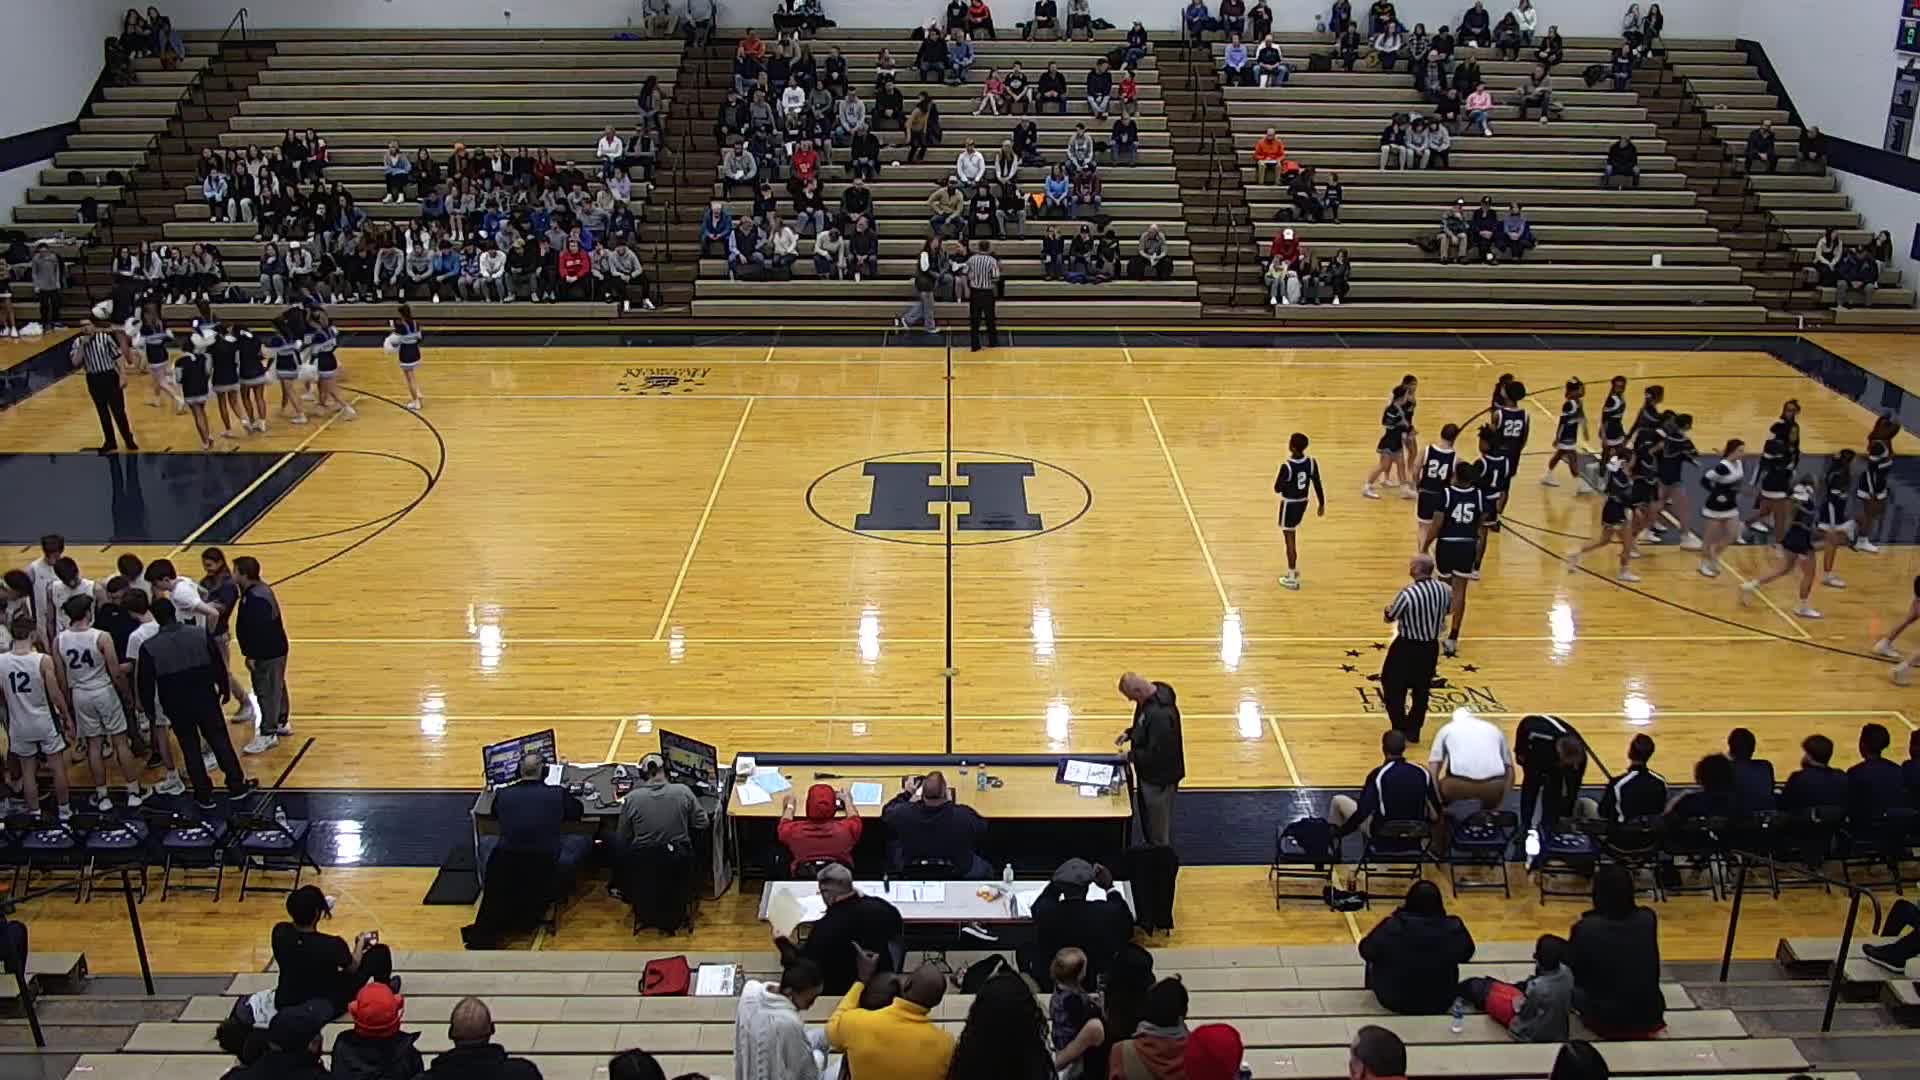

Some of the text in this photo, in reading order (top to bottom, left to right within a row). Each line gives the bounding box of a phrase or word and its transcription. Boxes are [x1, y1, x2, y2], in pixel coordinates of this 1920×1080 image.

[1503, 419, 1523, 437] 22
[1428, 459, 1449, 480] 24
[1490, 469, 1499, 487] 1
[1297, 471, 1307, 490] 2
[854, 461, 1044, 531] H
[1451, 503, 1476, 524] 45
[66, 649, 95, 669] 24
[8, 671, 32, 693] 12
[1354, 686, 1499, 705] HSON
